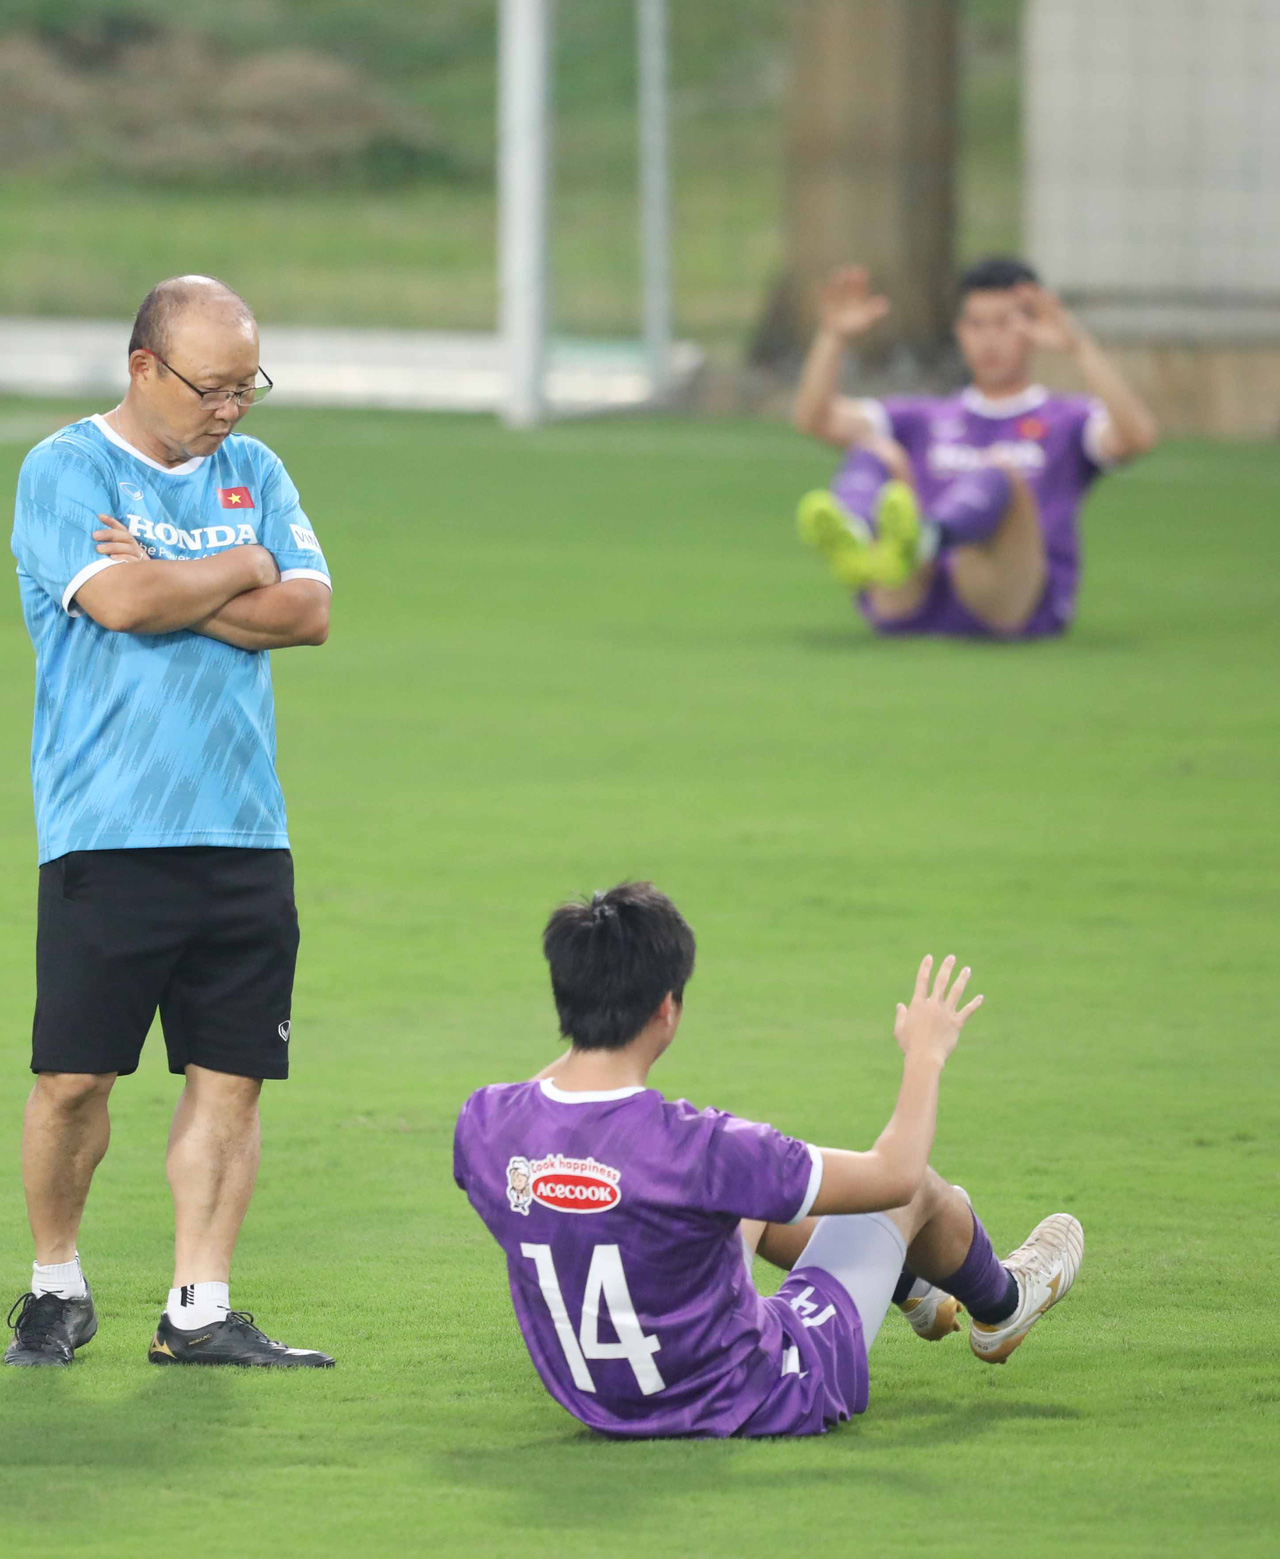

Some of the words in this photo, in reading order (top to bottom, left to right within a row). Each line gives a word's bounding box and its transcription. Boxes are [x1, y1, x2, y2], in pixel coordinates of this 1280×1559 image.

[127, 514, 258, 550] HONDA
[531, 1158, 555, 1173] Cook
[559, 1157, 617, 1181] happiness
[520, 1243, 666, 1396] 14
